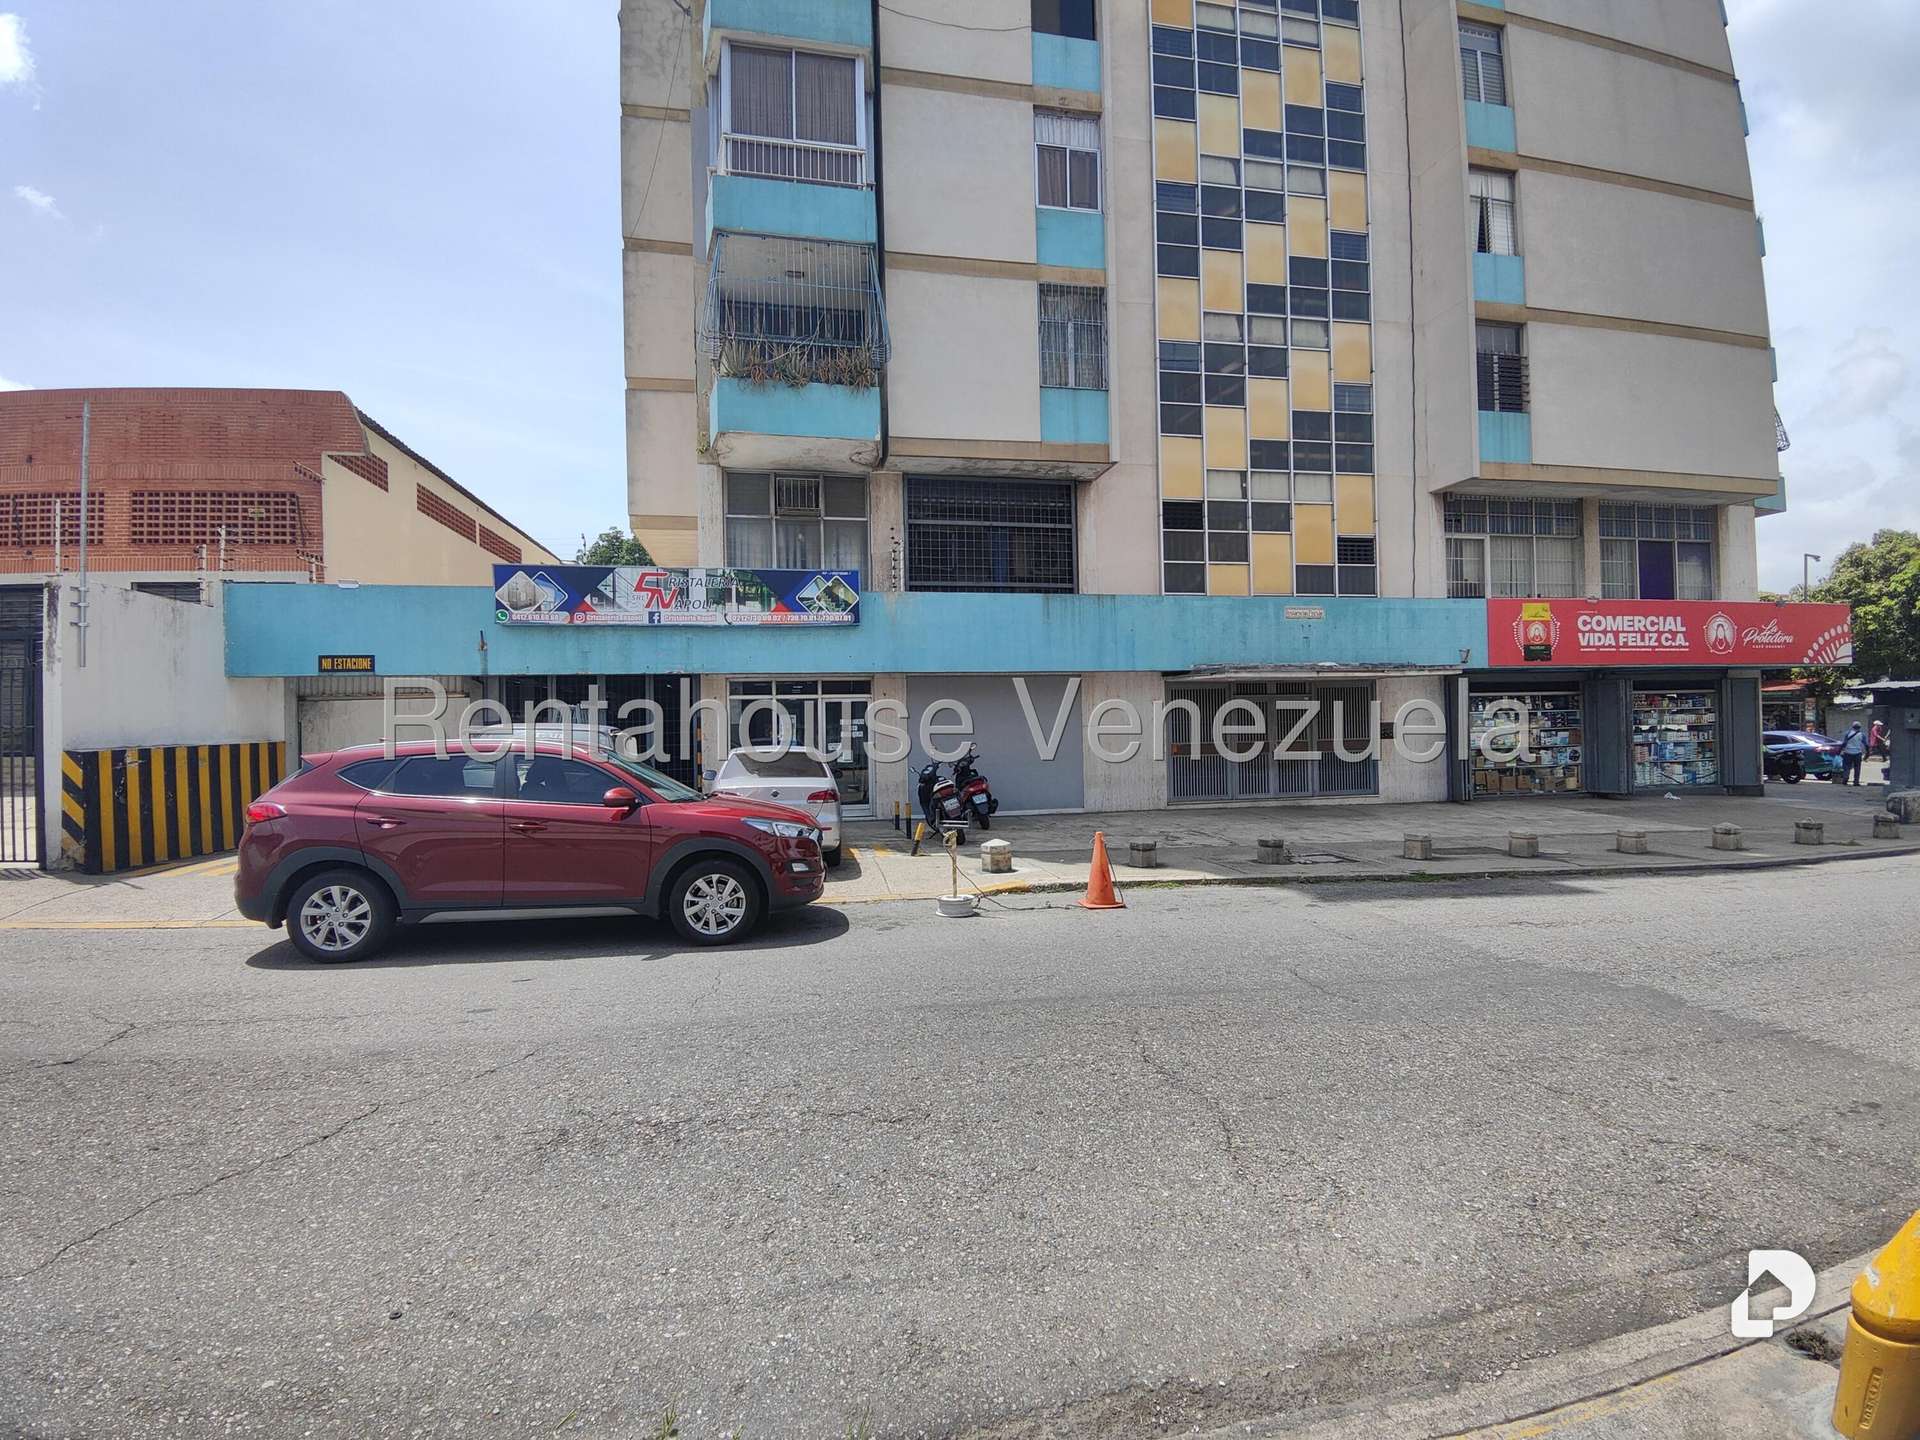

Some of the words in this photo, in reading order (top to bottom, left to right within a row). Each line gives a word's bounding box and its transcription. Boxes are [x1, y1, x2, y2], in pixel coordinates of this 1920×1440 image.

[1577, 615, 1686, 632] COMERCIAL
[1761, 618, 1779, 635] La
[1578, 632, 1616, 646] VIDA
[1618, 632, 1659, 646] FELIZ
[1661, 632, 1690, 646] C.A.
[1742, 627, 1794, 647] Protectora
[321, 657, 332, 670] NO
[334, 657, 373, 670] ESTACIONE
